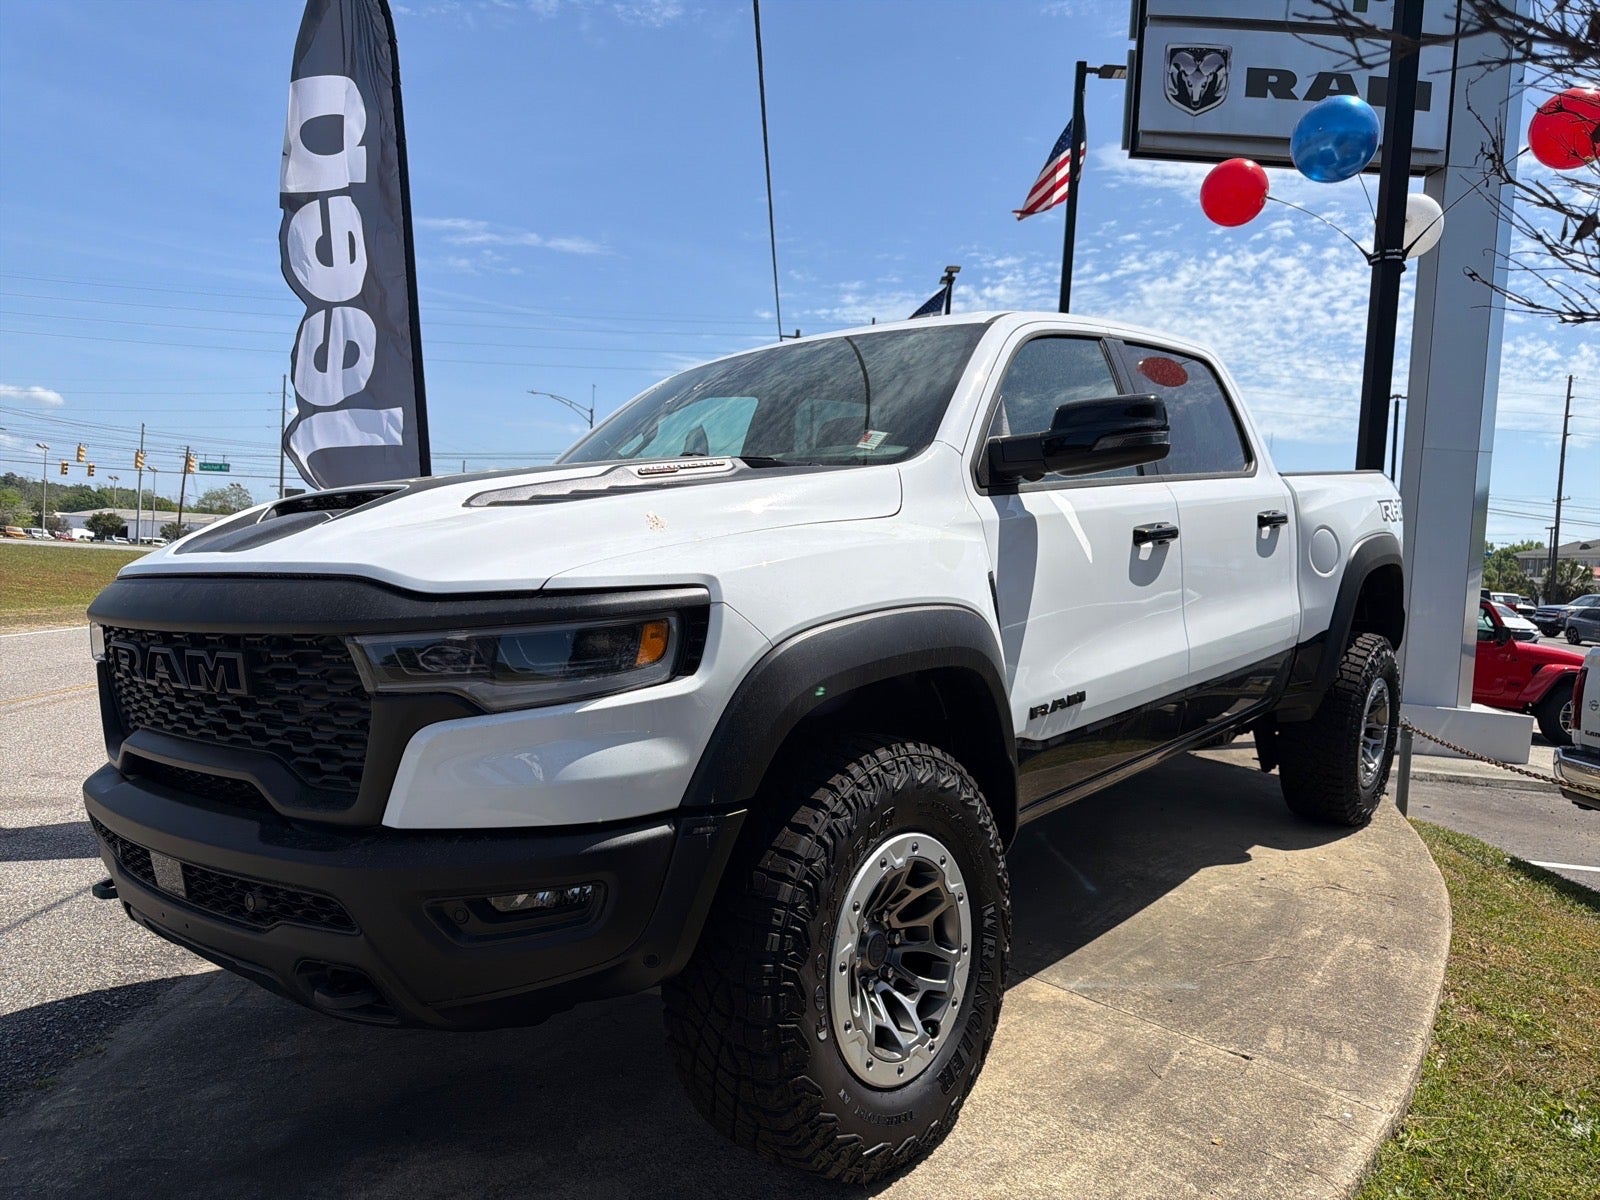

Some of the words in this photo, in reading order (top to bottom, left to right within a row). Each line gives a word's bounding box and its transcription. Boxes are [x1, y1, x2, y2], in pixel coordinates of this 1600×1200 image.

[106, 640, 248, 695] RAM
[1029, 691, 1086, 720] RAM
[936, 901, 998, 1097] WRANGLER
